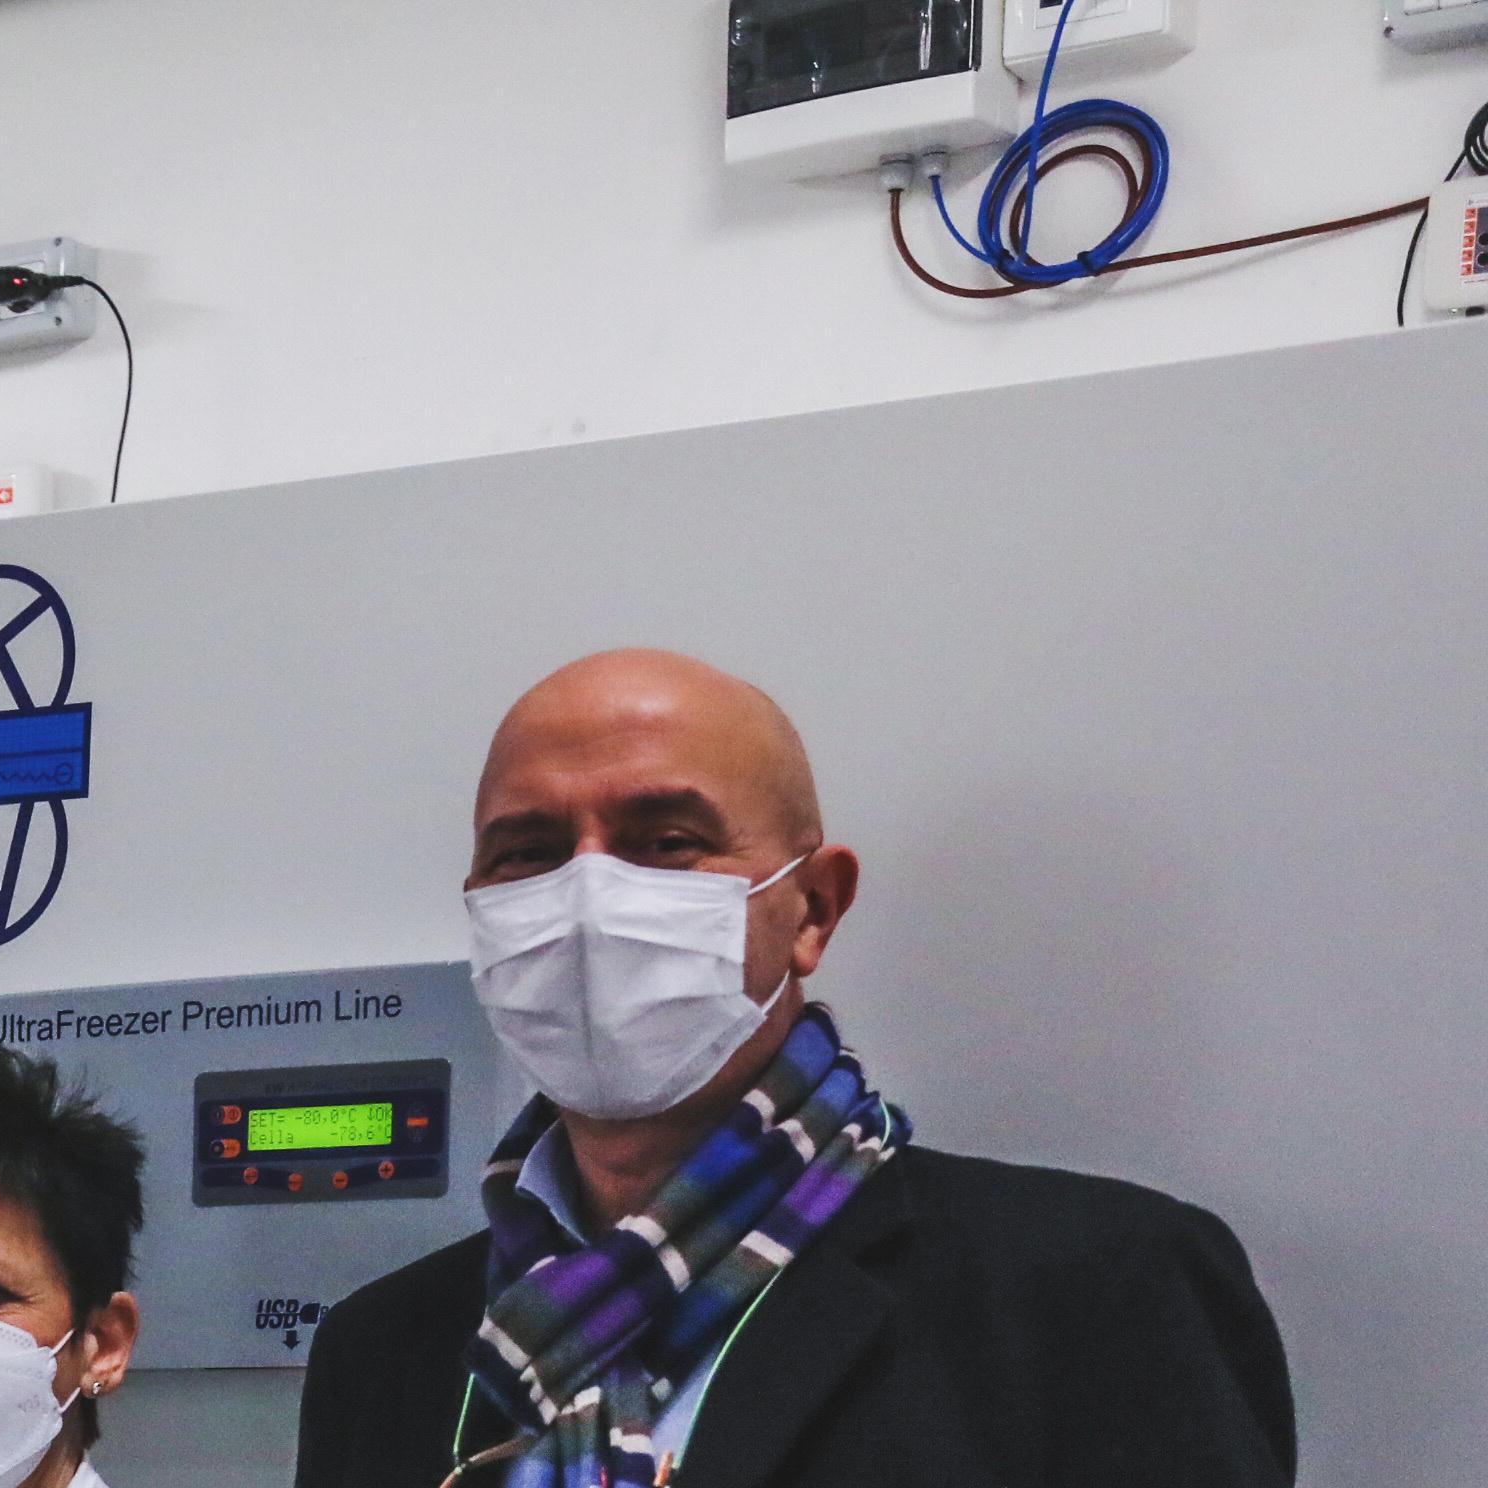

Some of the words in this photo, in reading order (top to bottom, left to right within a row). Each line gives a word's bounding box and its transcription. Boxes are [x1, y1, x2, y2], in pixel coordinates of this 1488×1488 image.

[182, 995, 322, 1031] Premium
[334, 988, 402, 1021] Line
[249, 1130, 294, 1145] Cella
[255, 1298, 300, 1330] USB
